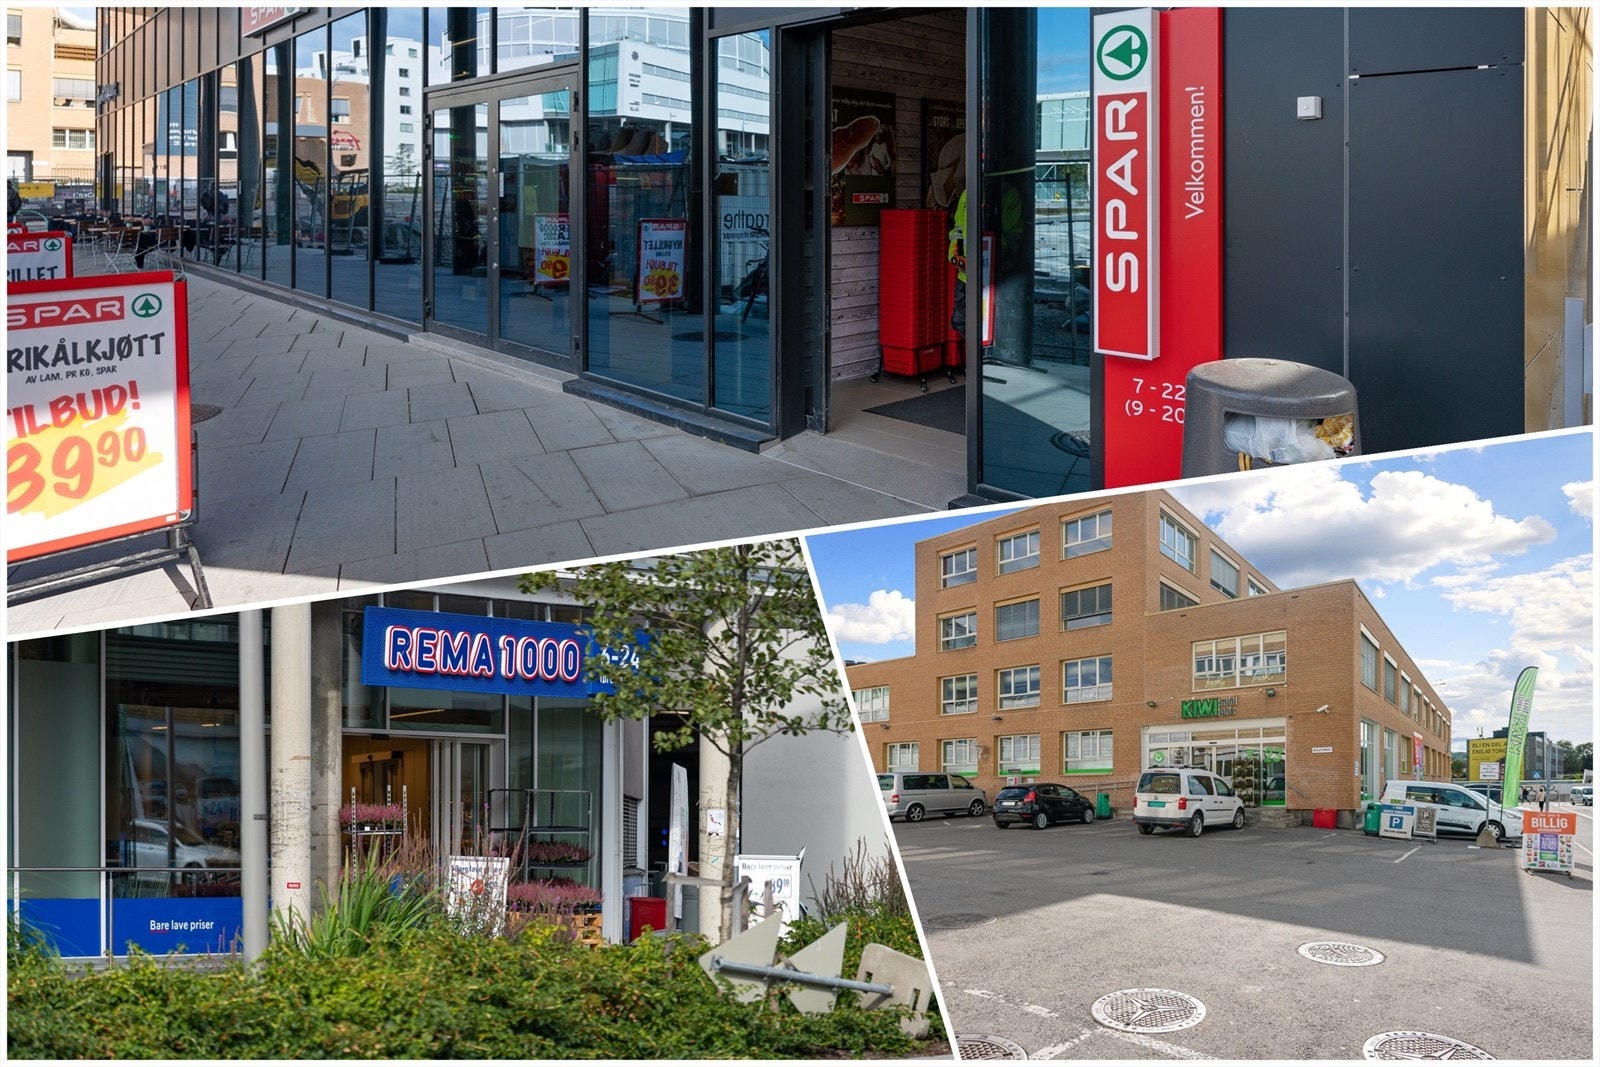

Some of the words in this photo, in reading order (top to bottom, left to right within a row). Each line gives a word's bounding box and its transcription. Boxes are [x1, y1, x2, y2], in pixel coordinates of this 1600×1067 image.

[1184, 85, 1206, 220] Velkommen!
[859, 194, 881, 202] SPAR
[1105, 97, 1139, 294] SPAR
[7, 302, 121, 327] SPAR
[25, 374, 37, 384] AV
[39, 372, 63, 383] LAM,
[65, 370, 78, 379] PR
[79, 368, 94, 377] KG,
[96, 365, 117, 376] SPAR
[1132, 377, 1144, 394] 7
[1161, 382, 1185, 401] 22
[7, 380, 140, 438] ILBUD!
[1125, 399, 1144, 417] (9
[384, 624, 495, 678] REMA
[499, 633, 580, 683] 1000
[1181, 698, 1219, 719] KIWI
[1263, 746, 1284, 763] 23
[1531, 816, 1569, 829] BILLIG
[741, 862, 757, 871] Bare
[758, 862, 773, 870] lave
[149, 919, 170, 931] Bare
[171, 919, 189, 931] lave
[190, 918, 214, 932] priser
